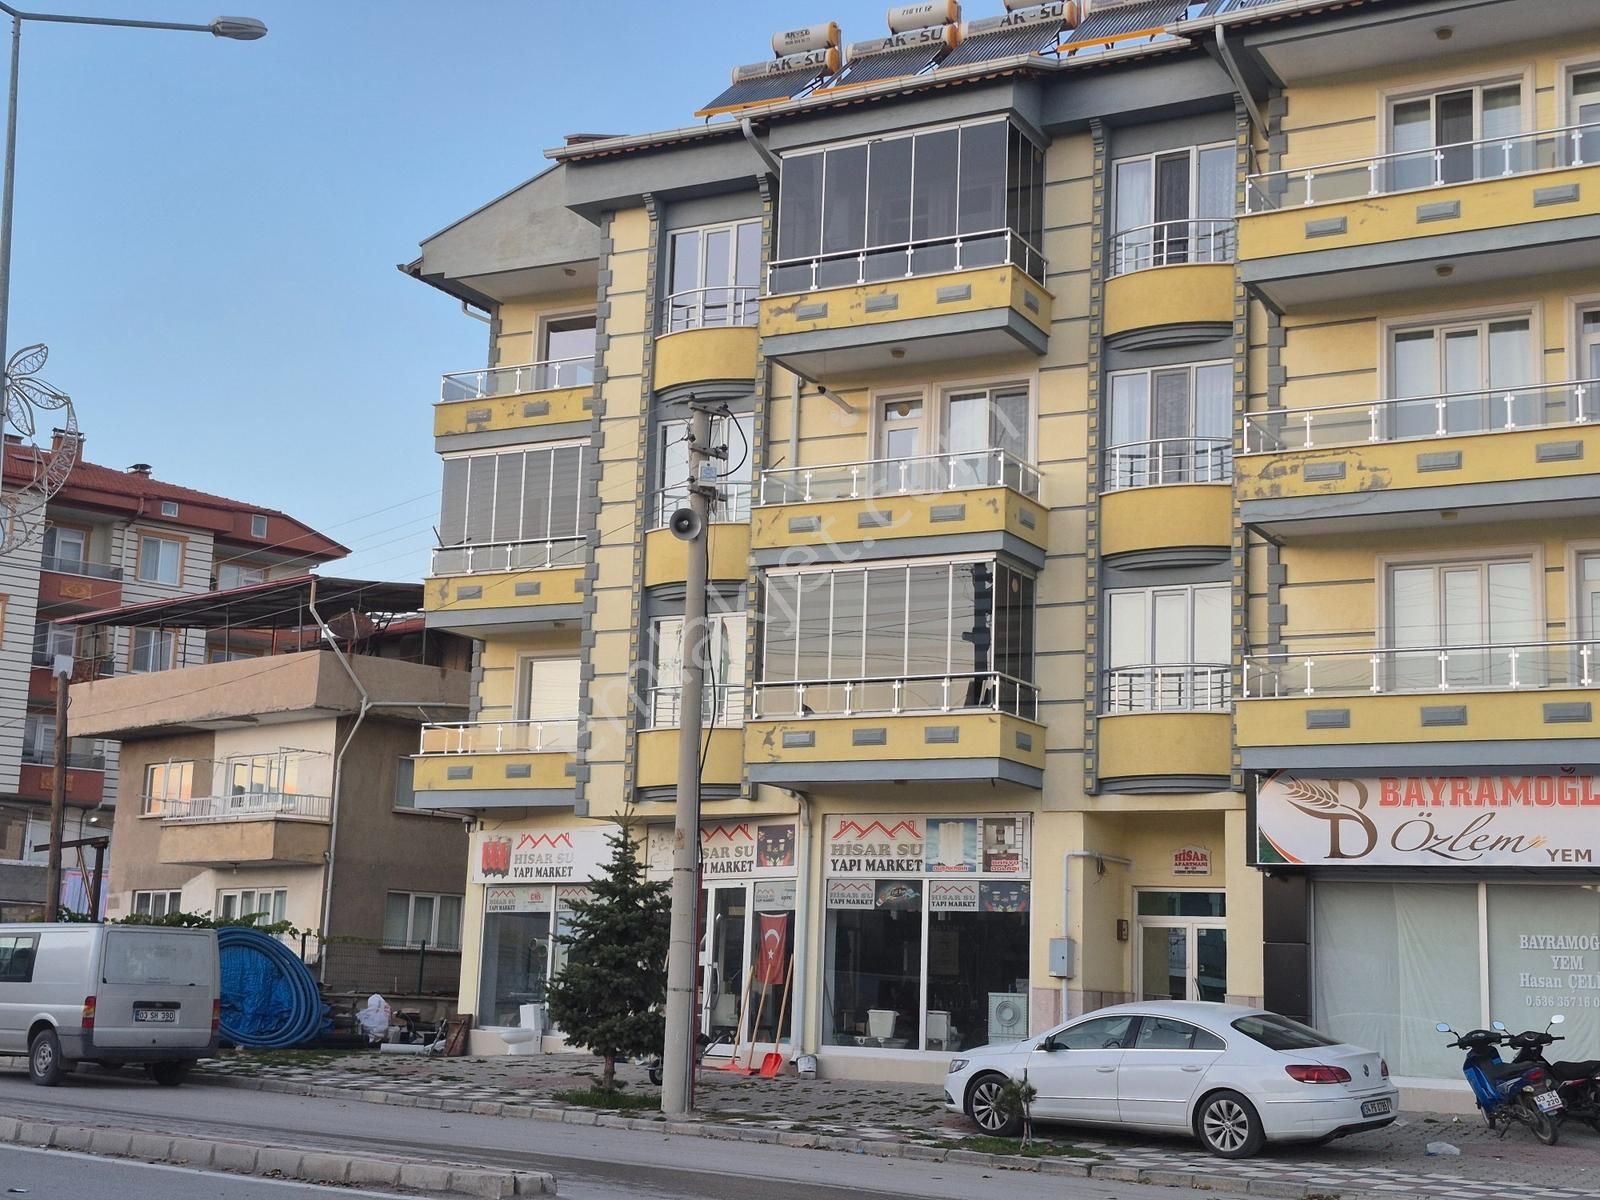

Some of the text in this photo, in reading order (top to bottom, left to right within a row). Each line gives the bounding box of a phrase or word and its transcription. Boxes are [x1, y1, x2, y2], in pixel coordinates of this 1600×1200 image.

[1391, 812, 1538, 861] Özlem
[734, 845, 754, 858] SU
[830, 841, 924, 856] HİSAR SU
[1174, 849, 1208, 861] HİSAR
[514, 851, 574, 864] HİSAR SU
[1546, 849, 1592, 863] YEM
[513, 866, 574, 878] YAPI MARKET
[710, 861, 754, 874] MARKET
[831, 859, 923, 872] YAPI MARKET
[1551, 955, 1584, 970] YEM
[1520, 973, 1562, 988] Hasan
